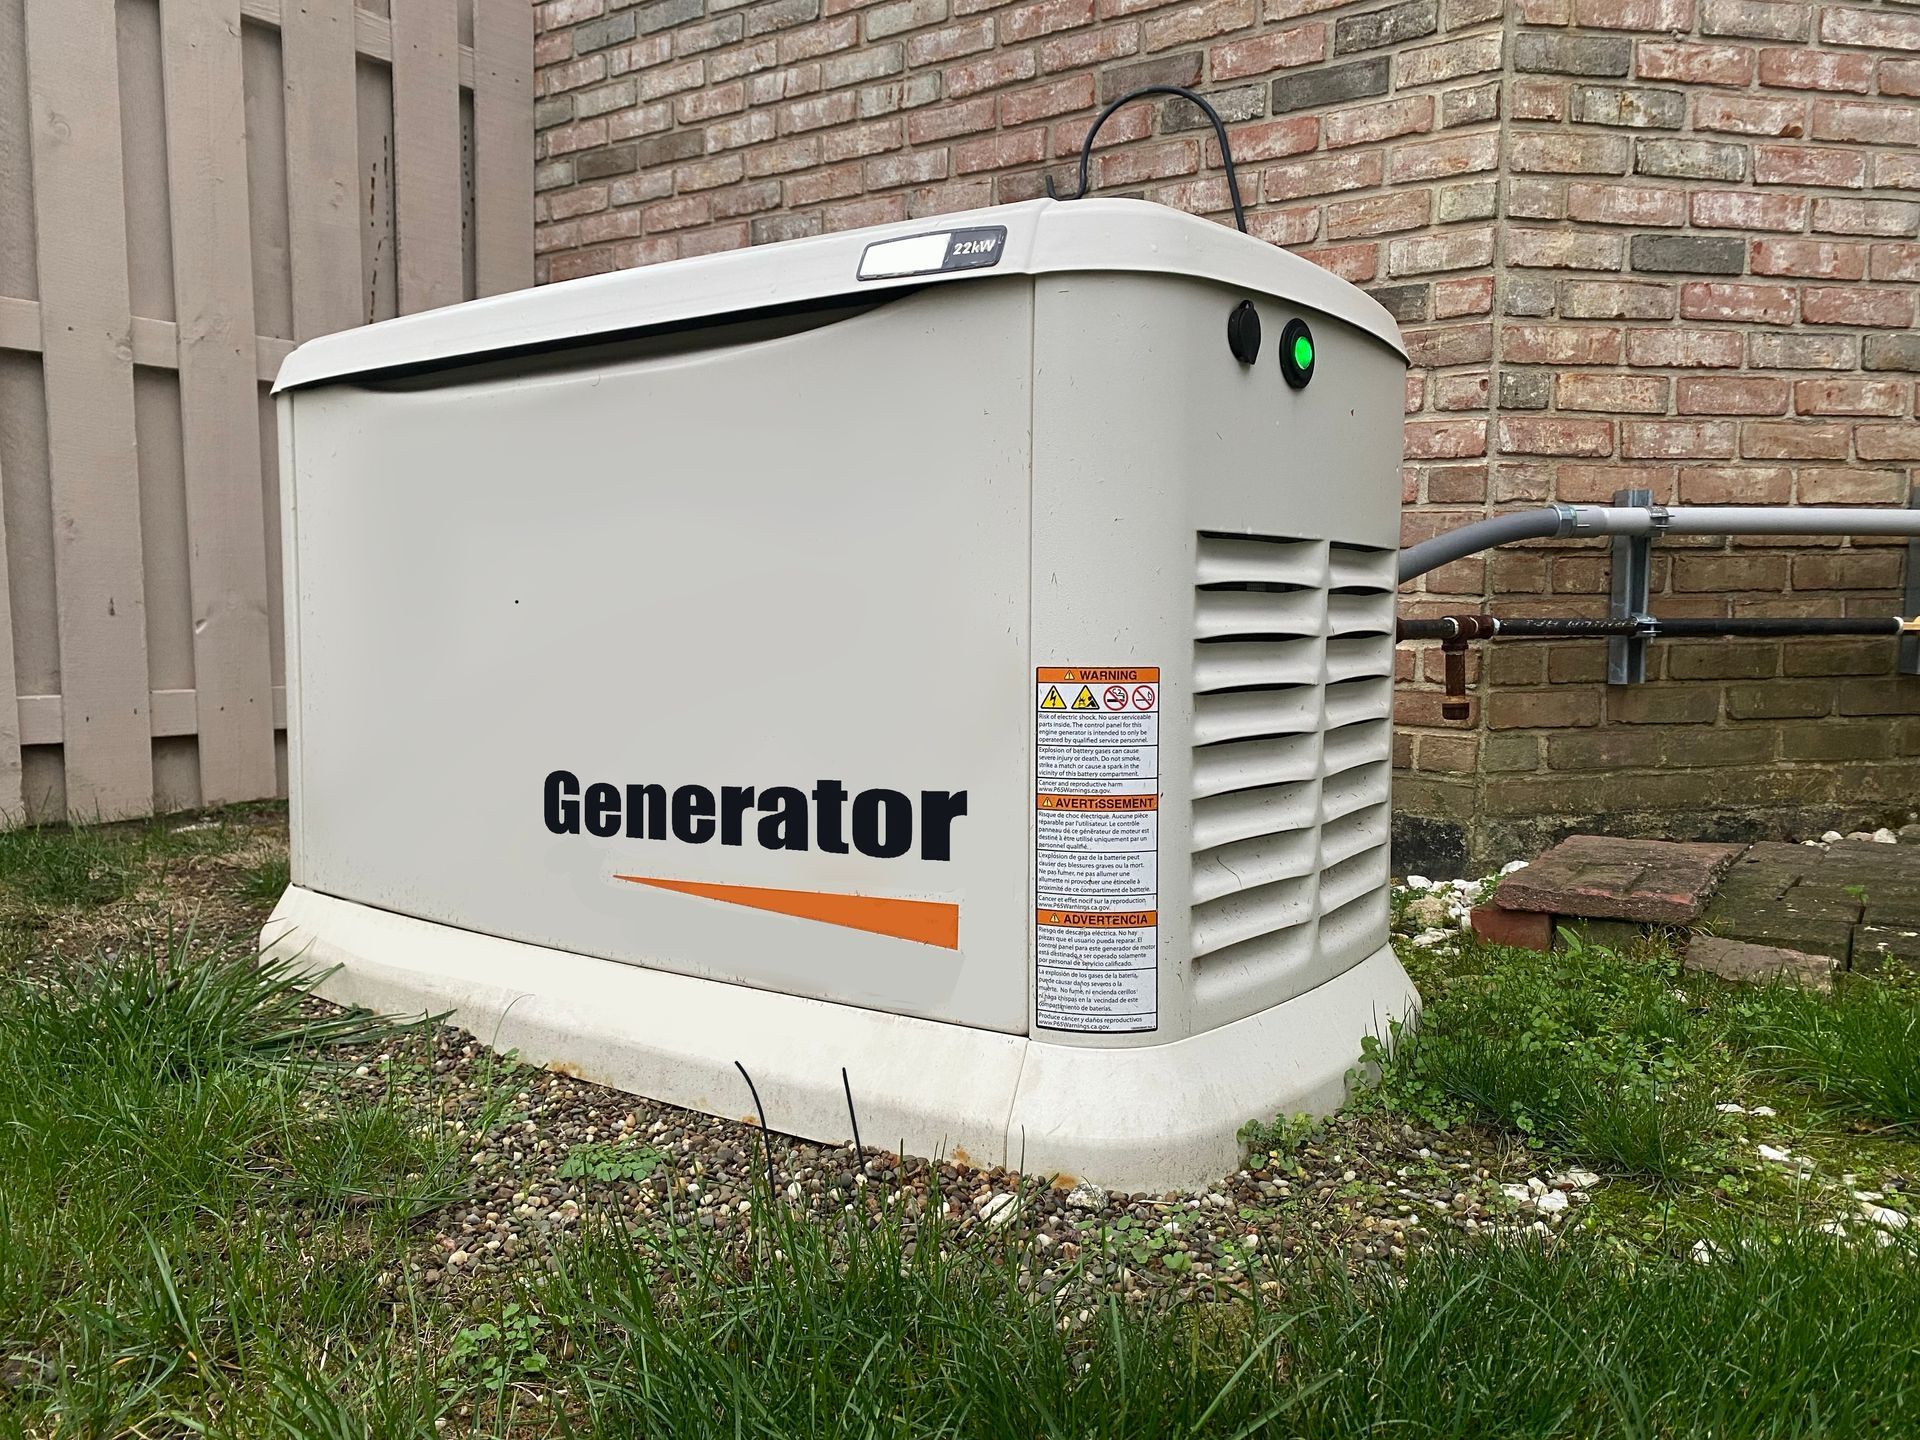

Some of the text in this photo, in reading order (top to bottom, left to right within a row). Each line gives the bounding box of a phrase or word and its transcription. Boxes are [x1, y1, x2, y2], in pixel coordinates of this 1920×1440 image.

[953, 239, 996, 255] 22kW
[1080, 671, 1137, 680] WARNING
[1056, 798, 1154, 808] AVERTISSEMENT
[544, 770, 968, 861] Generator
[1064, 914, 1148, 925] ADVERTENCIA
